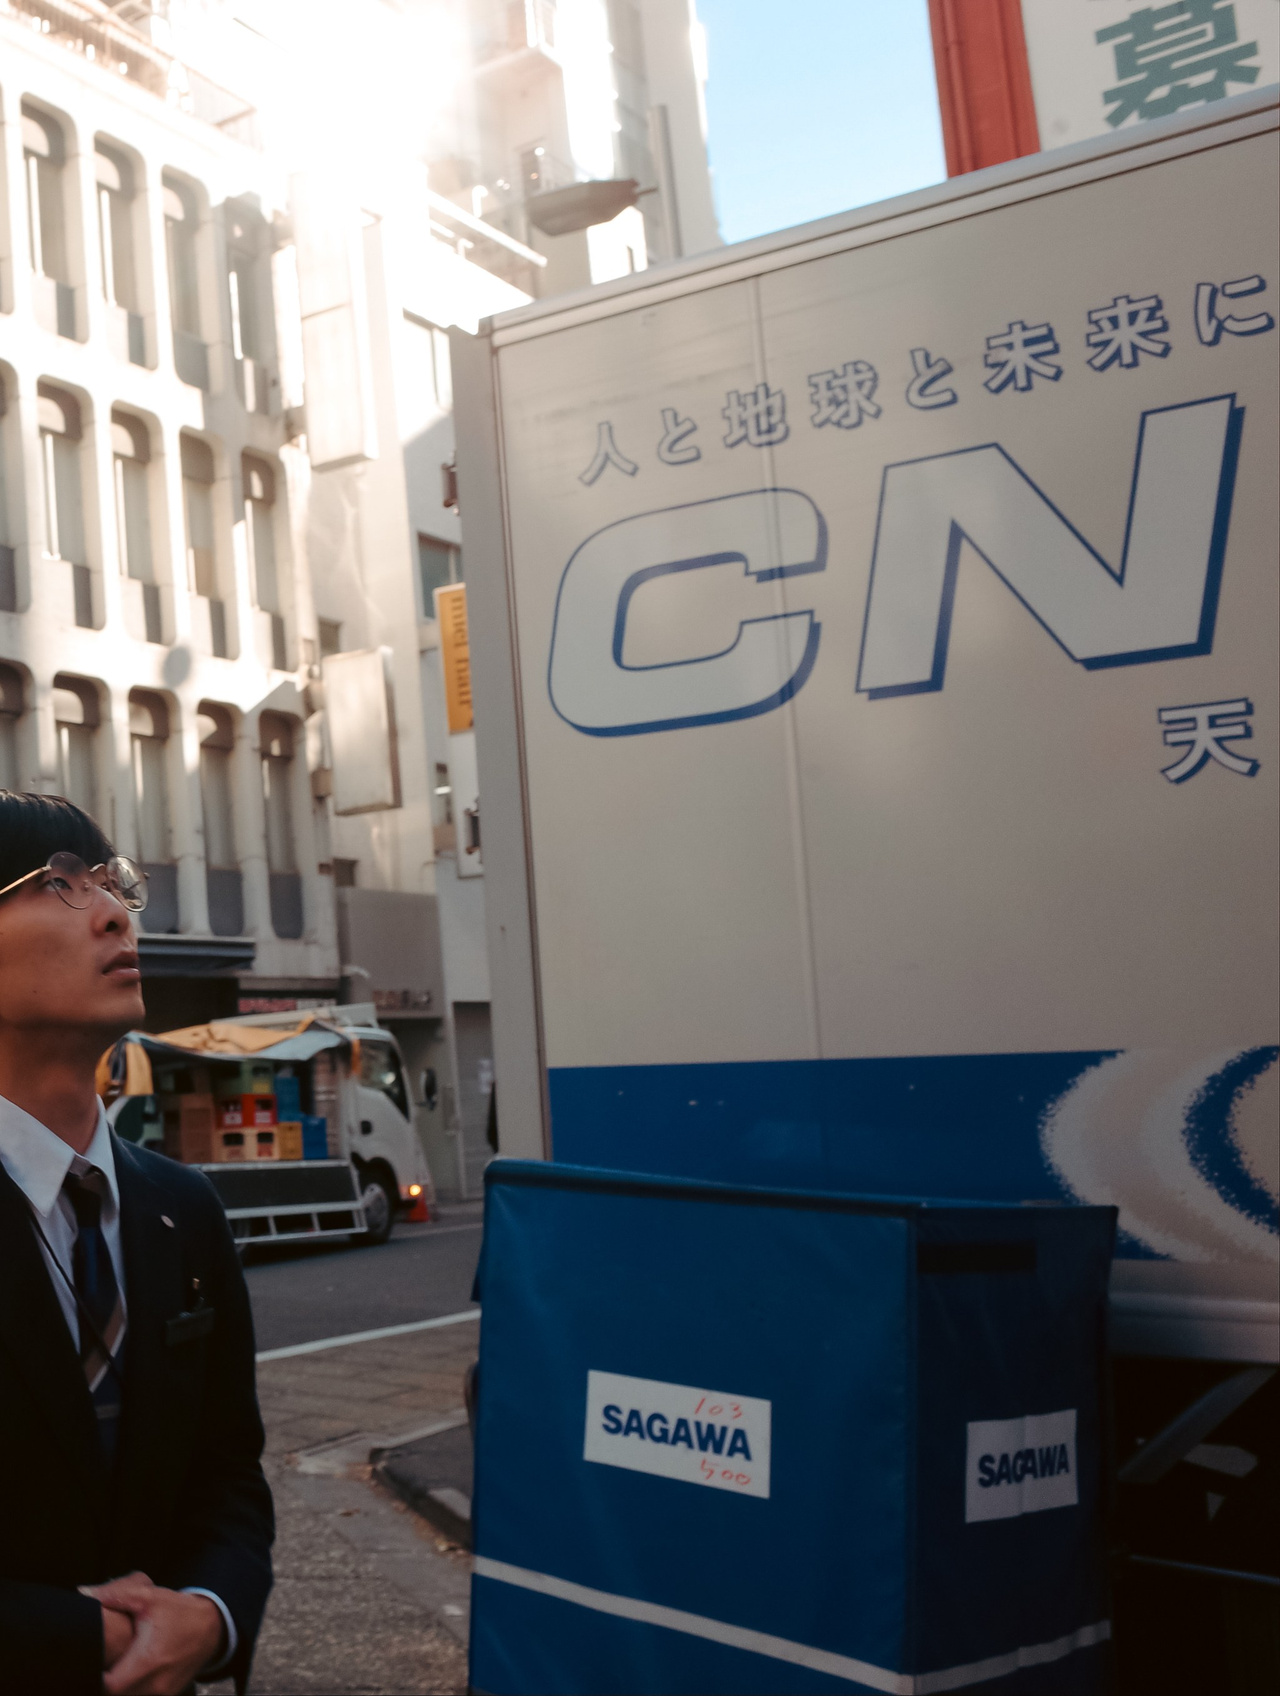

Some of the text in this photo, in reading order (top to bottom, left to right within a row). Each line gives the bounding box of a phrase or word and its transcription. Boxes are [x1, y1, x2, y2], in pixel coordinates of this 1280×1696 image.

[577, 275, 1275, 486] 人と地球と未来に
[547, 392, 1246, 738] CN
[1158, 697, 1261, 785] 天
[602, 1404, 753, 1462] SAGAWA
[978, 1442, 1070, 1488] SAGAWA
